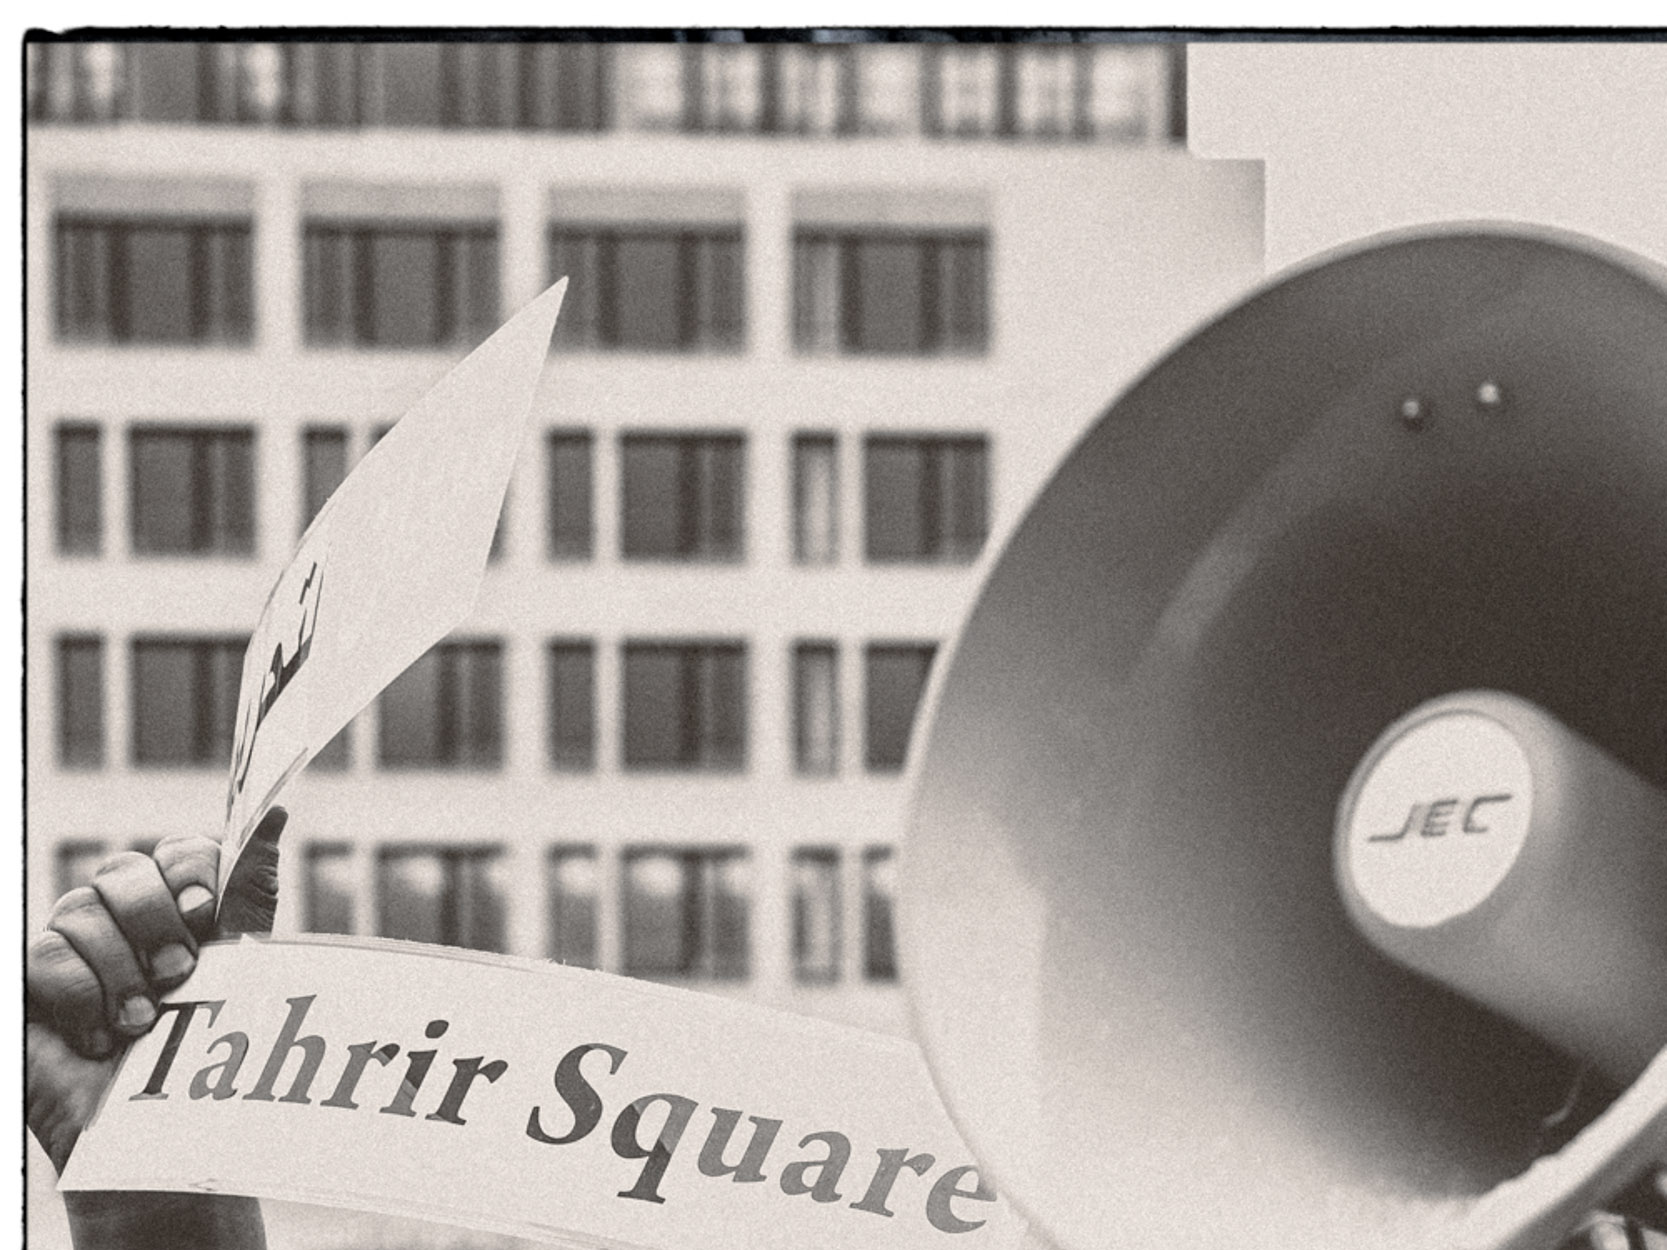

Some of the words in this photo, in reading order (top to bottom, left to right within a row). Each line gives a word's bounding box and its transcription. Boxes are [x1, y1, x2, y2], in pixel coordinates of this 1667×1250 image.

[1367, 794, 1512, 843] JEC
[128, 993, 508, 1126] Tahrir
[526, 1042, 998, 1235] Square
